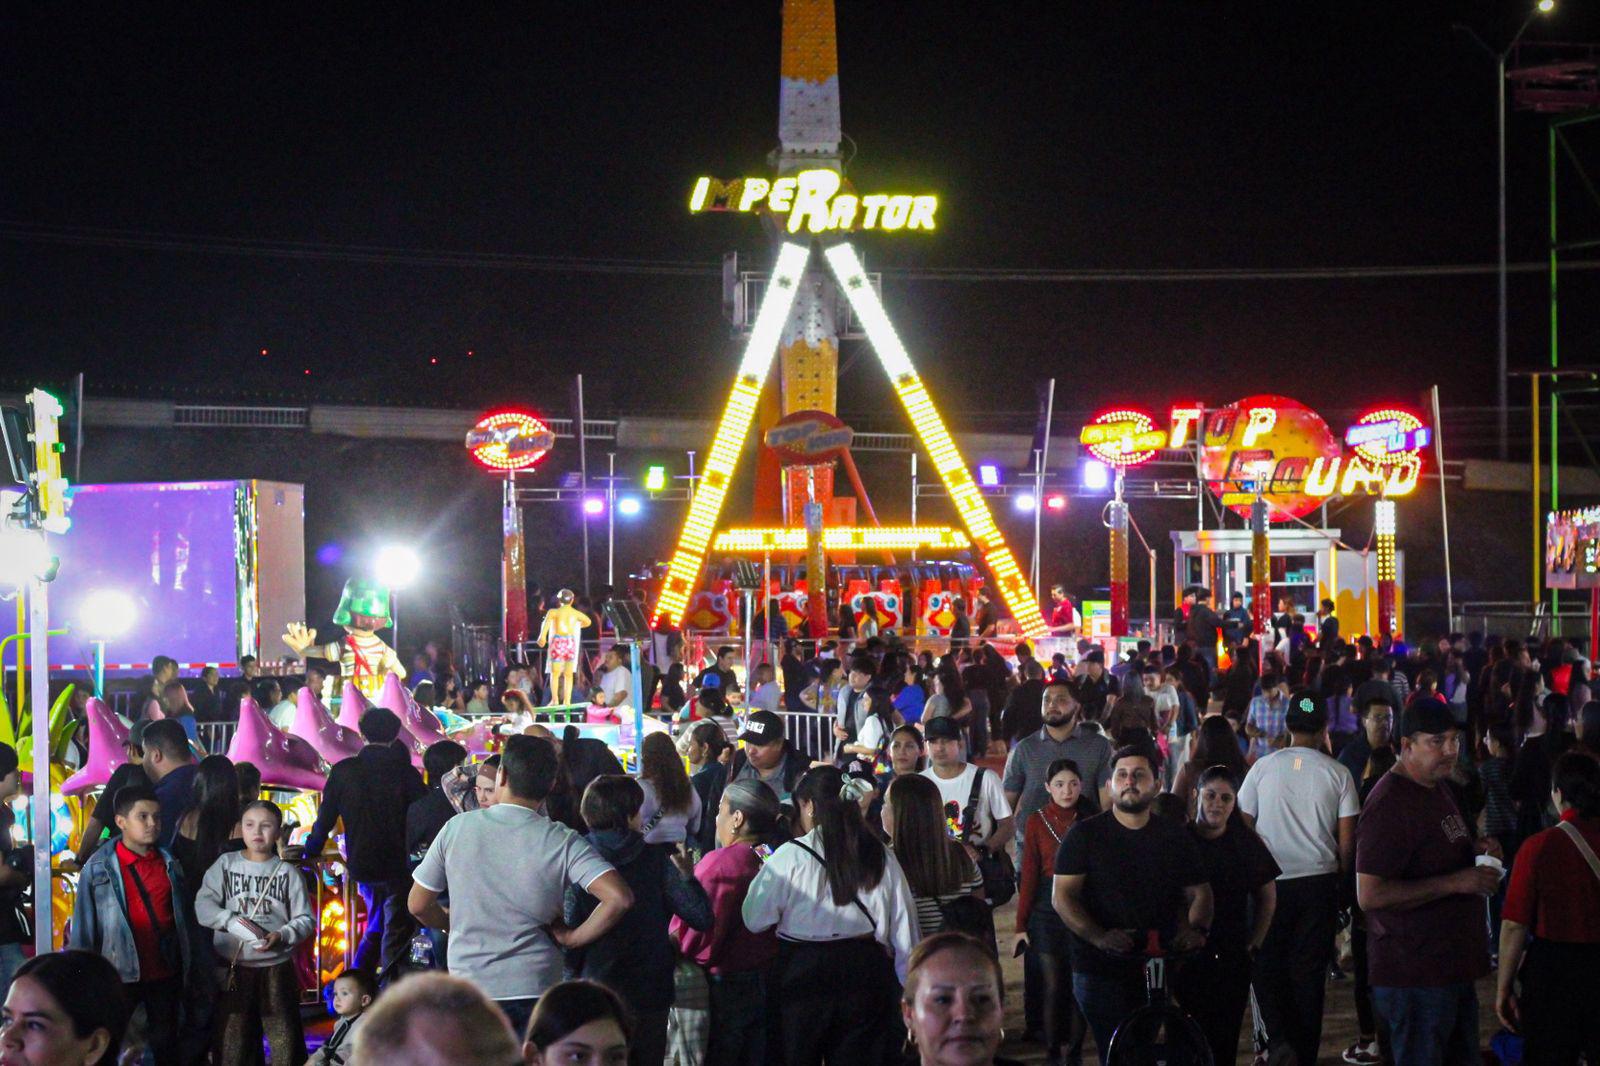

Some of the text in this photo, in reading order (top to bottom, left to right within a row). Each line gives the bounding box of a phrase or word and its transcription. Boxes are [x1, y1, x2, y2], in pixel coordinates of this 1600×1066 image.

[689, 169, 938, 234] IMPERATOR
[1169, 407, 1277, 447] TOP
[222, 870, 291, 901] NEW YORK
